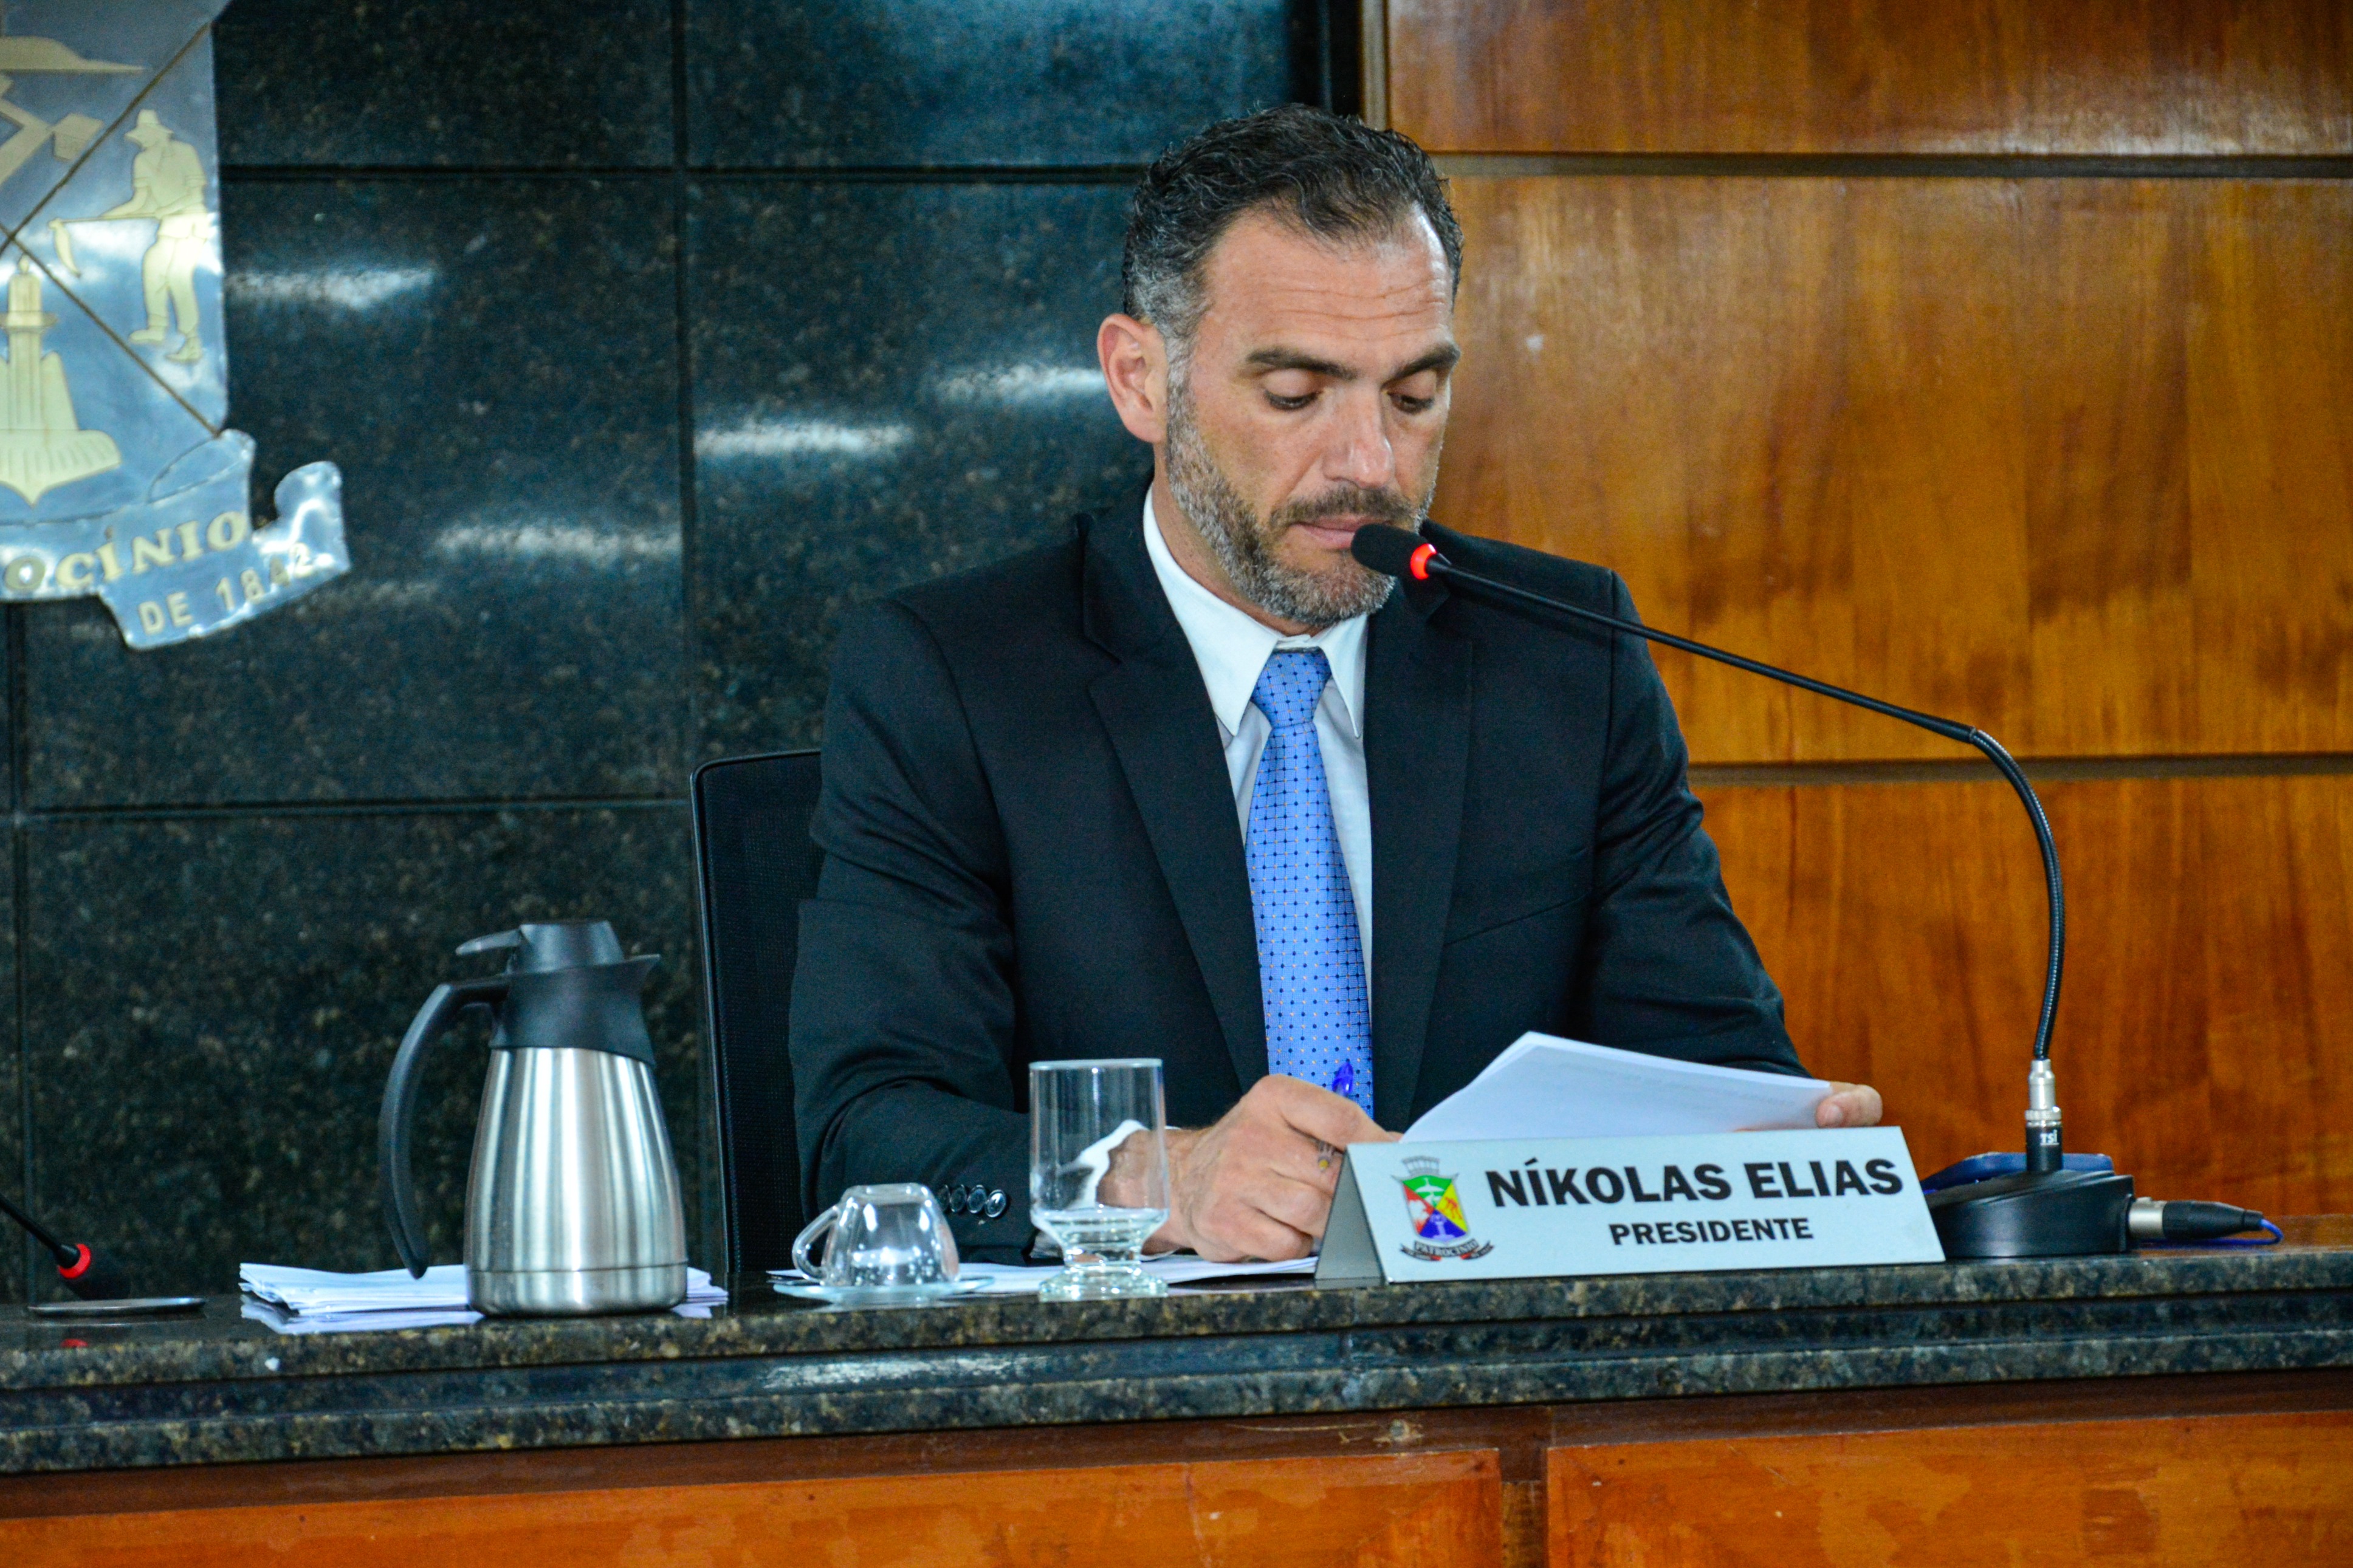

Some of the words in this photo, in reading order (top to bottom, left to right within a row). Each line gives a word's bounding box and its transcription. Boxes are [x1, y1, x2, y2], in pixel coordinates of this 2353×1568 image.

[138, 591, 193, 635] DE
[215, 543, 314, 612] 1842
[1485, 1157, 1732, 1207] NÍKOLAS
[1743, 1158, 1903, 1199] ELIAS
[1608, 1217, 1814, 1245] PRESIDENTE
